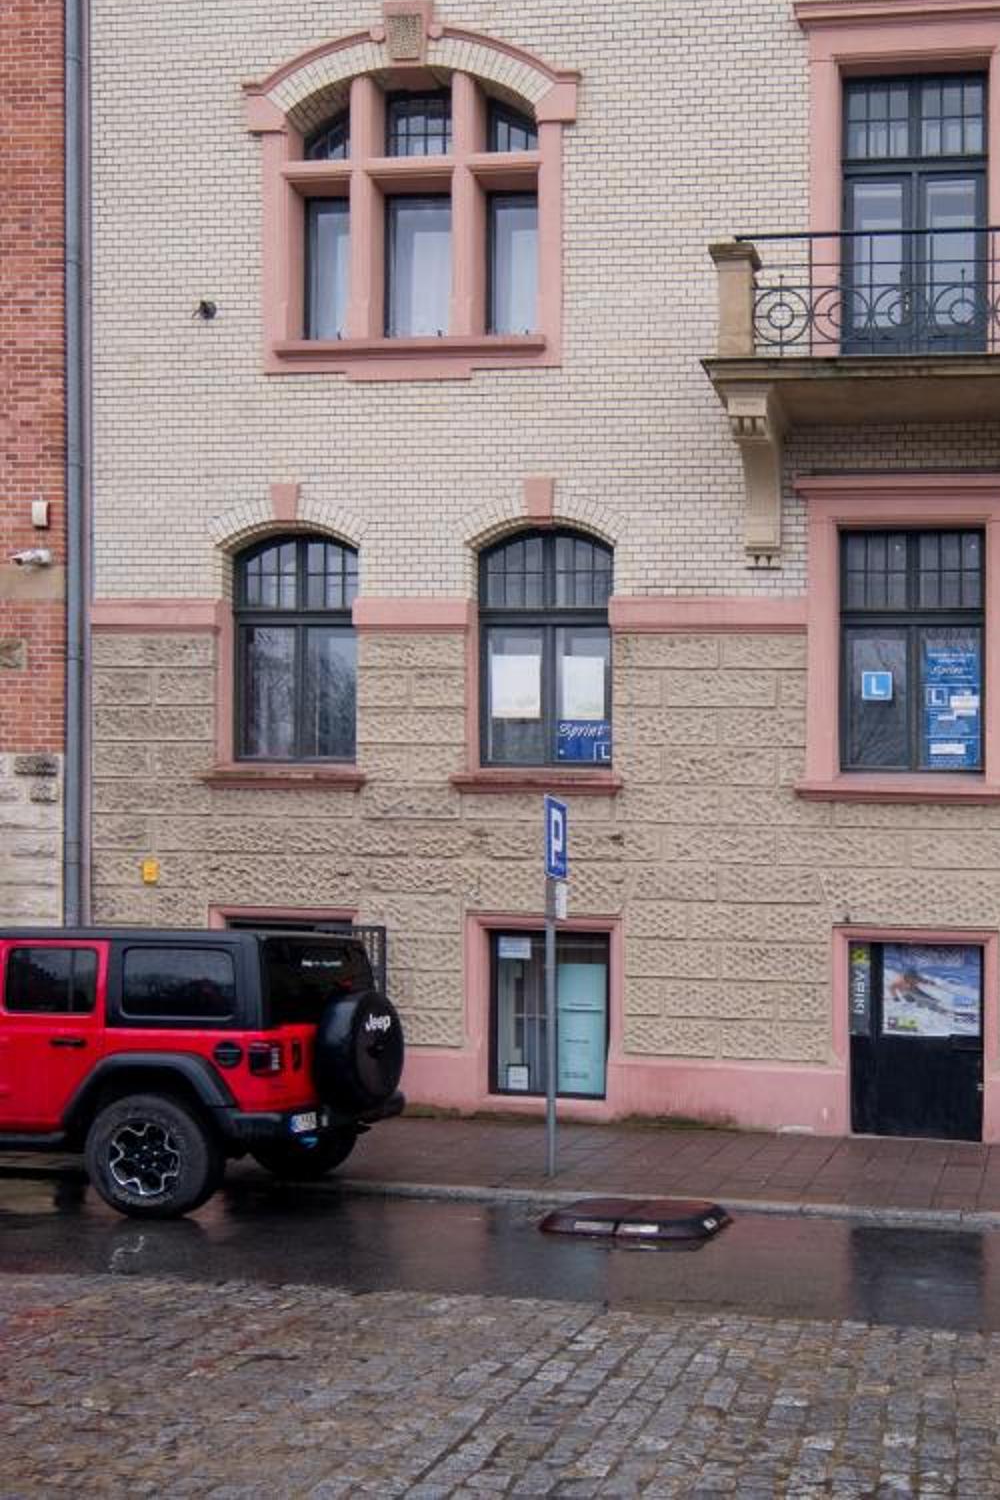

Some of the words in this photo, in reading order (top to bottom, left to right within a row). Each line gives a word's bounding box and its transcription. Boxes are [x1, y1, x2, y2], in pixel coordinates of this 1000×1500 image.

[871, 675, 885, 695] L
[551, 807, 563, 867] P
[365, 1014, 391, 1032] Jeep
